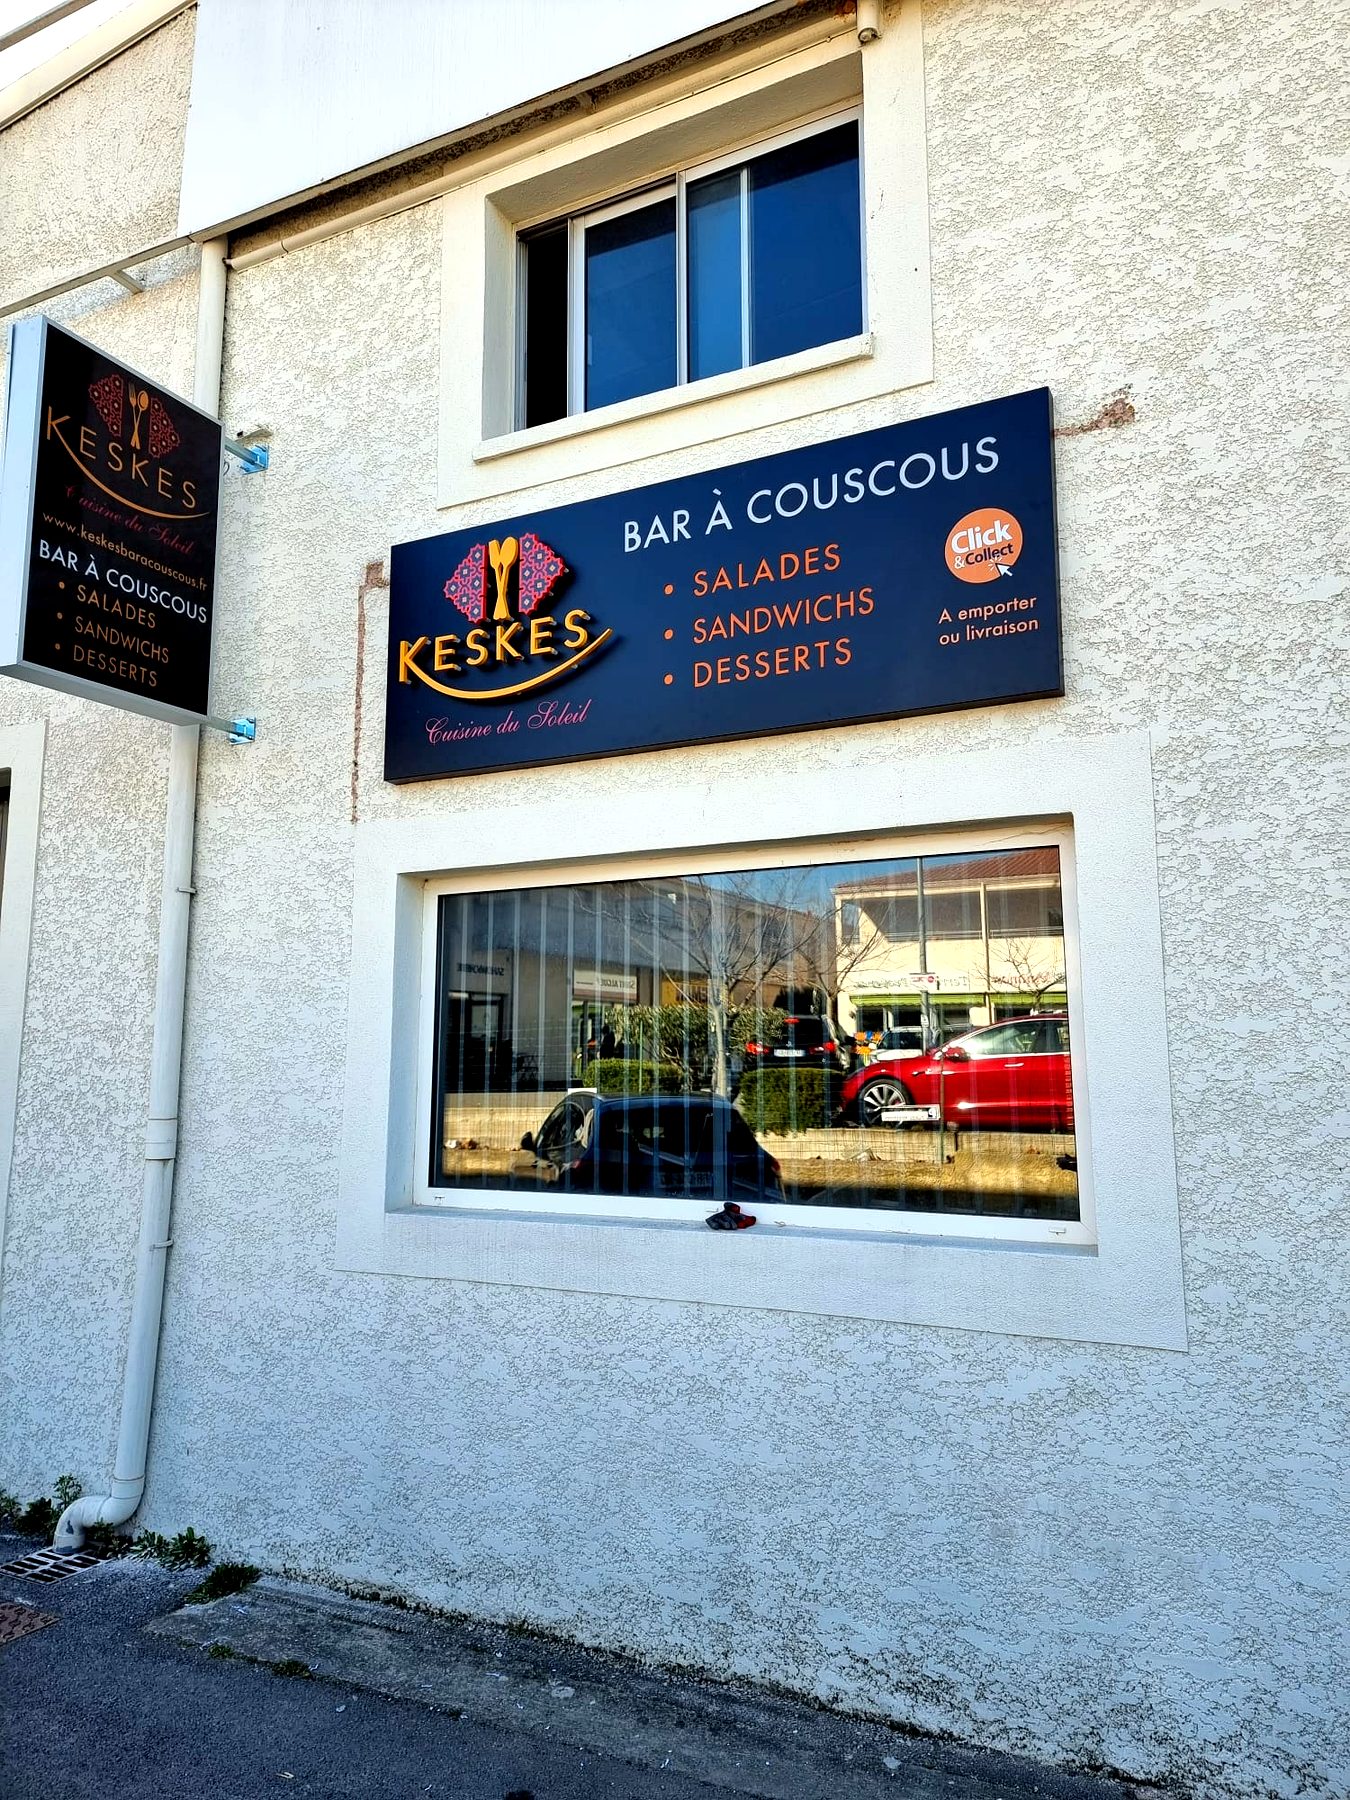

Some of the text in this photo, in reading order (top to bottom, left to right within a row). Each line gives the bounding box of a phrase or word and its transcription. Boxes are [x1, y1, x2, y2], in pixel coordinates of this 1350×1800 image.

[46, 406, 198, 509] KESKES
[624, 436, 999, 552] BAR À COUSCOUS
[43, 512, 208, 591] www.keskesbaracouscous.fr
[124, 514, 145, 533] du
[148, 524, 196, 556] Soleil
[951, 520, 1013, 554] Click
[39, 539, 208, 624] BAR À COUSCOUS
[693, 544, 841, 596] SALADES
[77, 584, 156, 629] SALADES
[693, 587, 875, 644] SANDWICHS
[939, 597, 1037, 624] A emporter
[75, 615, 169, 664] SANDWICHS
[399, 609, 592, 684] KESKES
[939, 619, 1039, 645] ou livraison
[73, 645, 158, 688] DESSERTS
[693, 637, 853, 688] DESSERTS
[425, 699, 592, 745] Cuisine du Soleil
